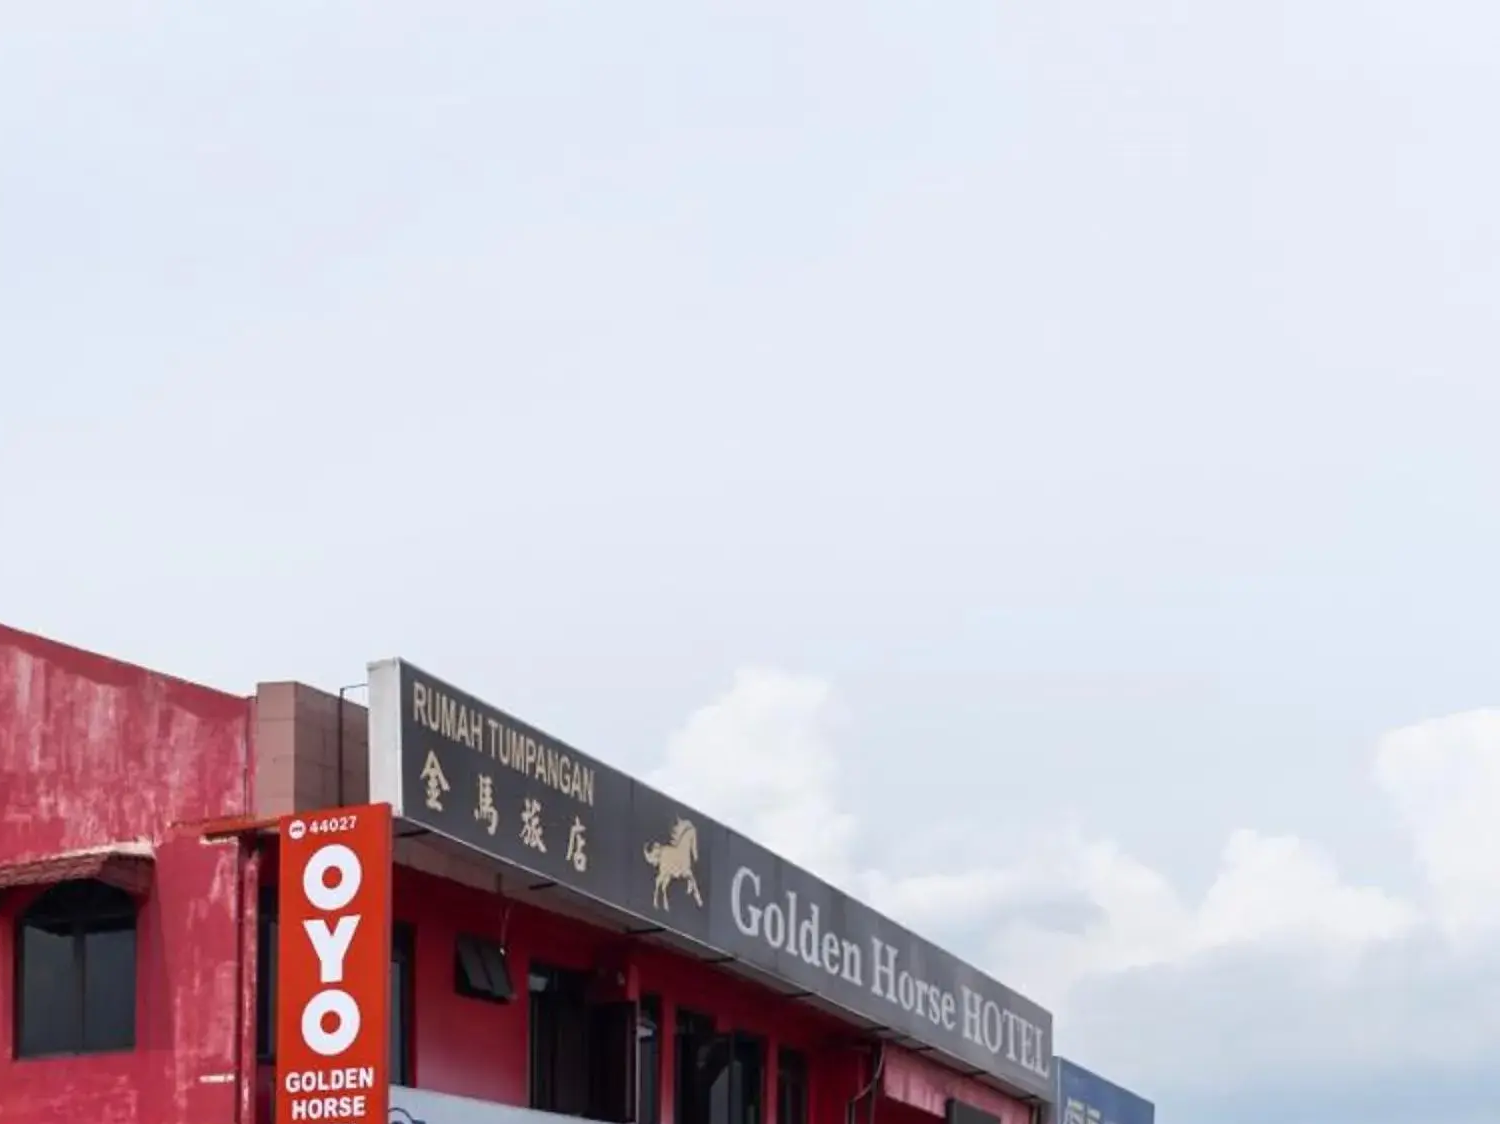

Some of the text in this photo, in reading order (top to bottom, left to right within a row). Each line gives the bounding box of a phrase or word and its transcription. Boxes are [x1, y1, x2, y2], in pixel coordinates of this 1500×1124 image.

[412, 681, 595, 806] RUMAH TUMPANGAN
[309, 815, 358, 834] 44027
[301, 843, 362, 1056] OYO
[731, 866, 1049, 1079] Golden Horse HOTEL
[285, 1067, 373, 1093] GOLDEN
[291, 1096, 366, 1120] HORSE
